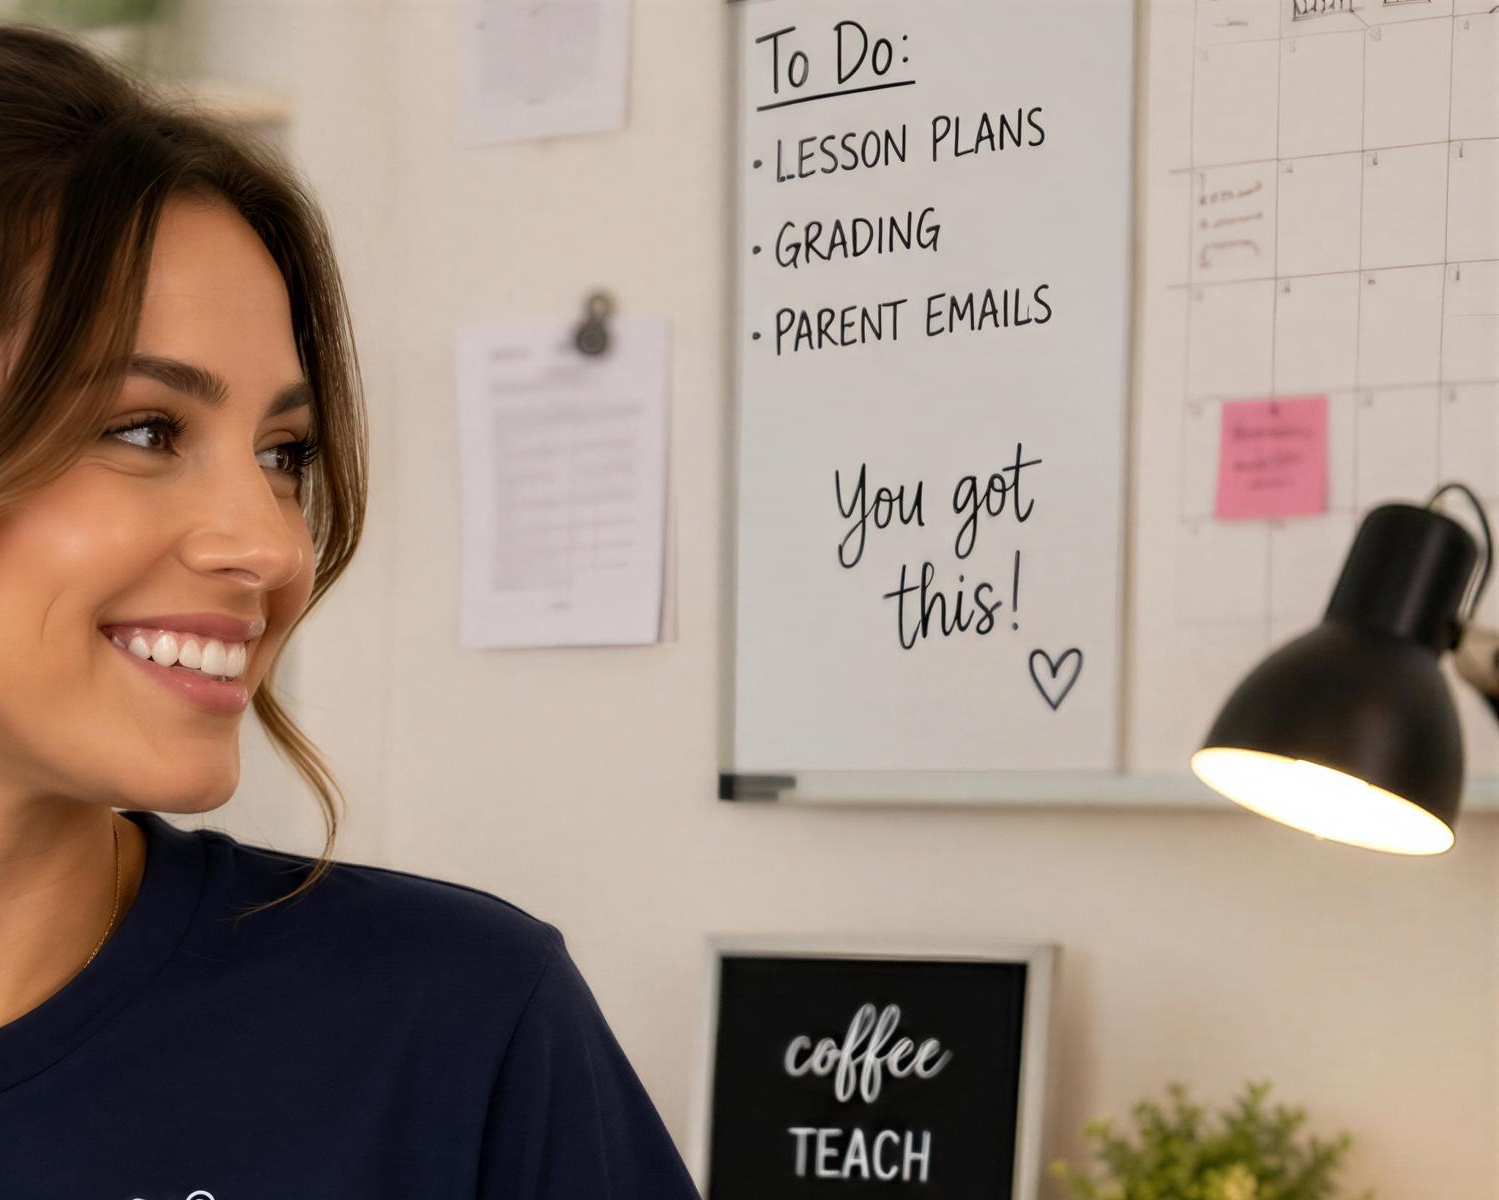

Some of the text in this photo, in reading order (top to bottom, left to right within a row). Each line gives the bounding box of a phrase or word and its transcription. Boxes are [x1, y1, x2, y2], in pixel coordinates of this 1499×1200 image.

[755, 20, 911, 95] To Do:
[775, 106, 1046, 184] LESSON PLANS
[774, 206, 941, 270] GRADING
[774, 283, 1053, 357] PARENT EMAILS
[834, 442, 1043, 569] You got
[883, 549, 1021, 651] this!
[784, 1003, 953, 1103] coffee
[787, 1126, 932, 1183] TEACH
